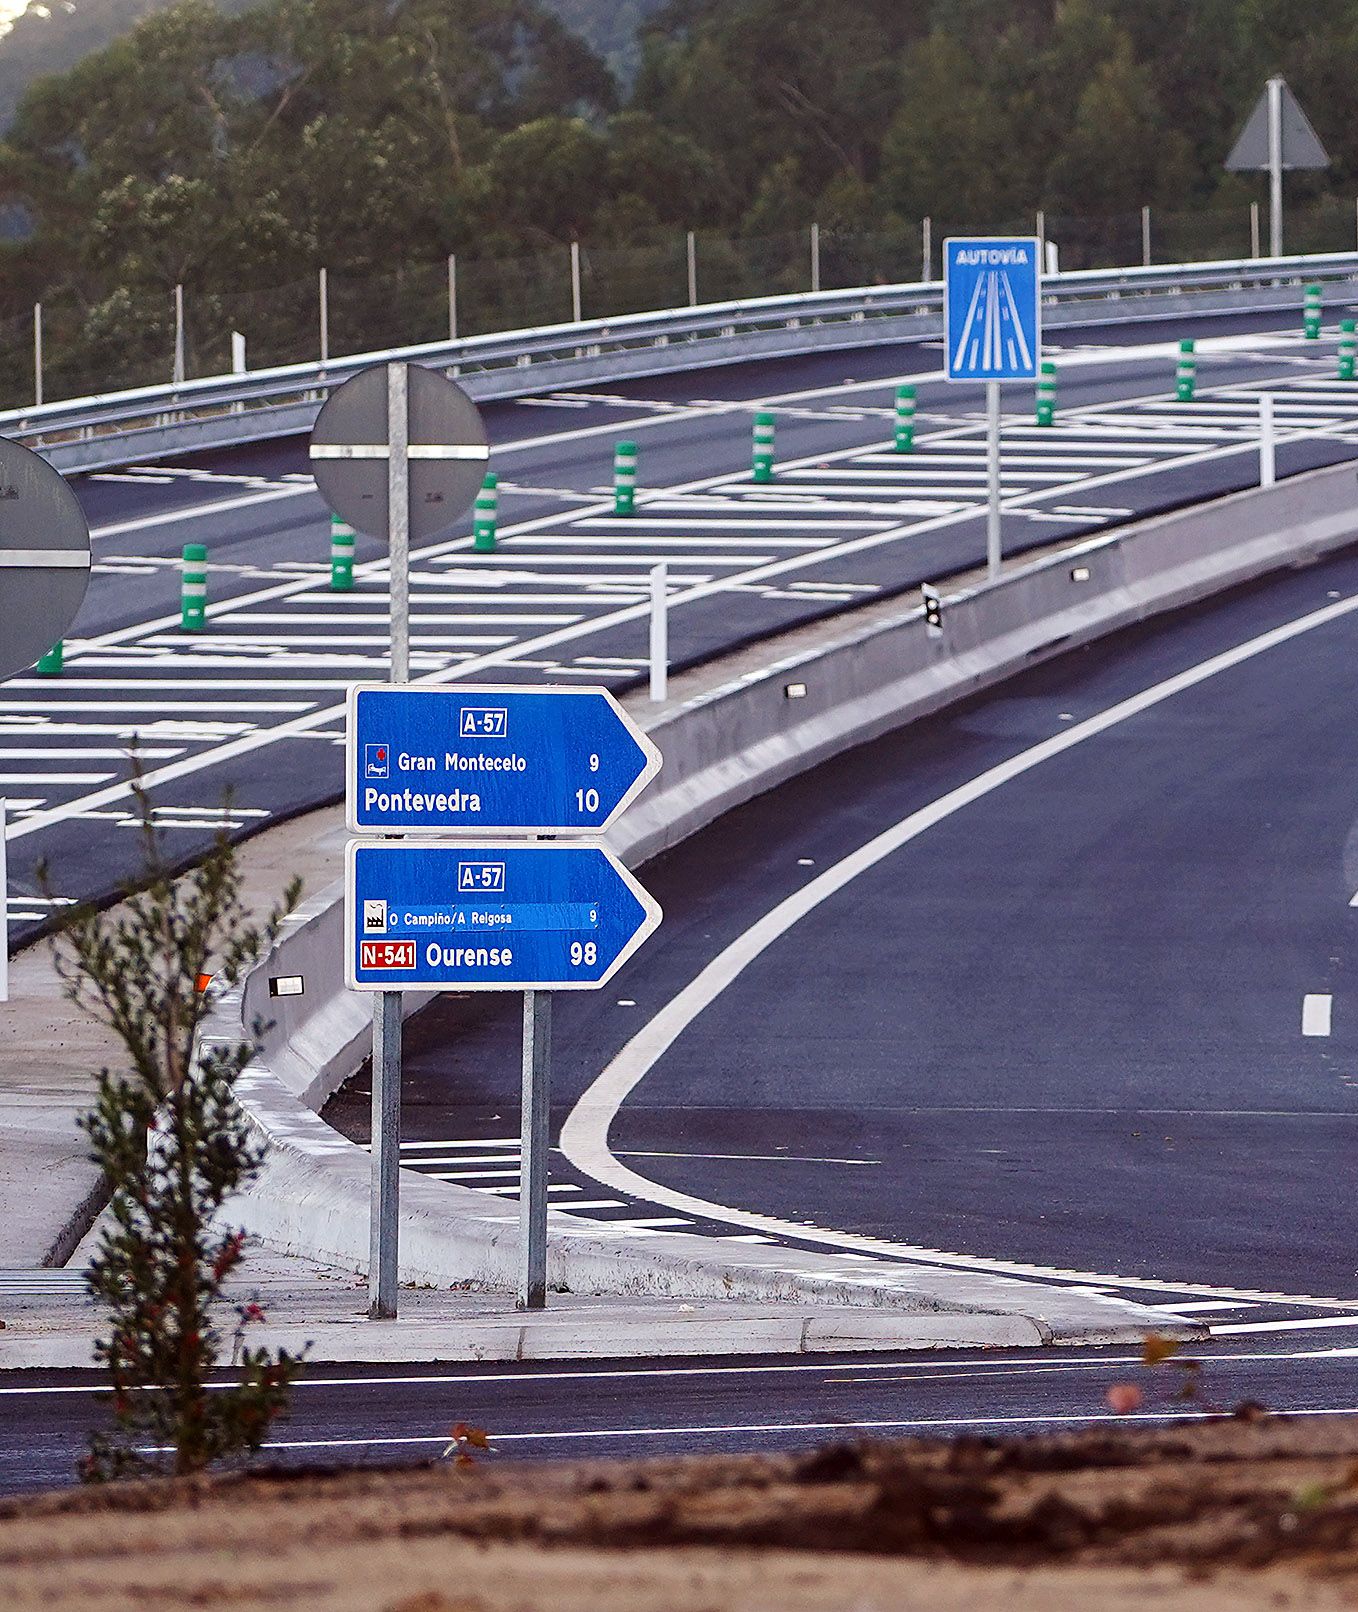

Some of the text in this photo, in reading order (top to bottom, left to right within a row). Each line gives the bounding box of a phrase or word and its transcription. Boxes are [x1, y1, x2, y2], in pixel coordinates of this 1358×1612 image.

[955, 246, 1029, 266] AUTOVÍA
[463, 713, 504, 733] A-57
[398, 753, 600, 772] Gran Montecelo 9
[365, 788, 600, 813] Pontevedra 10
[461, 867, 502, 887] A-57
[389, 913, 398, 926] O
[589, 910, 597, 923] 9
[363, 942, 597, 967] N-541 Ourense 98
